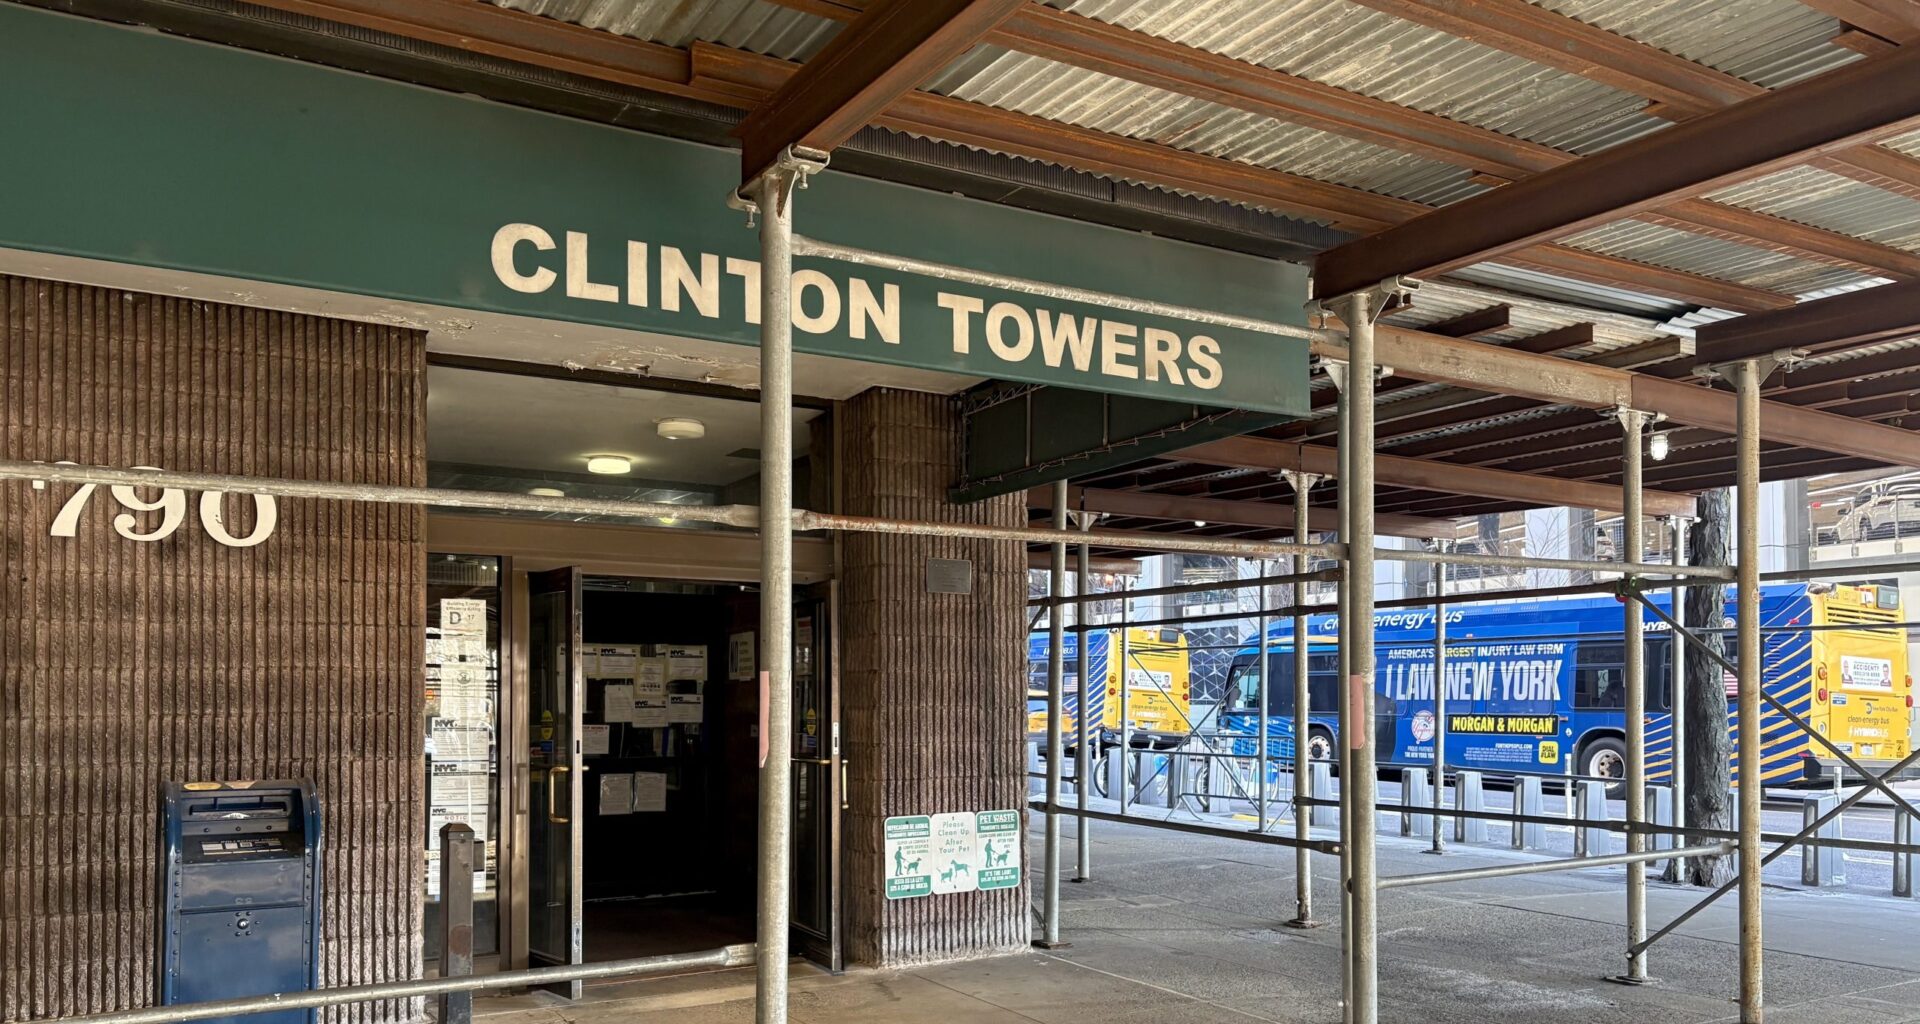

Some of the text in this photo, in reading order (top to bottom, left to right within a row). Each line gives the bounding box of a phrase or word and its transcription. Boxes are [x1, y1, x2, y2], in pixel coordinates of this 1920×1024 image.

[491, 223, 1223, 390] CLINTON TOWERS
[33, 460, 277, 547] 790
[450, 611, 462, 625] D
[1387, 647, 1435, 660] AMERICA'S
[1444, 645, 1476, 658] ARGEST
[1477, 645, 1513, 657] INJURY
[1514, 644, 1535, 656] LAW
[1385, 659, 1563, 700] I LAW NEW YORK
[1452, 716, 1494, 732] MORGAN
[1496, 717, 1505, 732] &
[1507, 717, 1553, 733] MORGAN
[434, 763, 457, 772] NYC
[980, 812, 1015, 824] PET WASTE
[960, 828, 970, 836] Up
[945, 838, 963, 846] After
